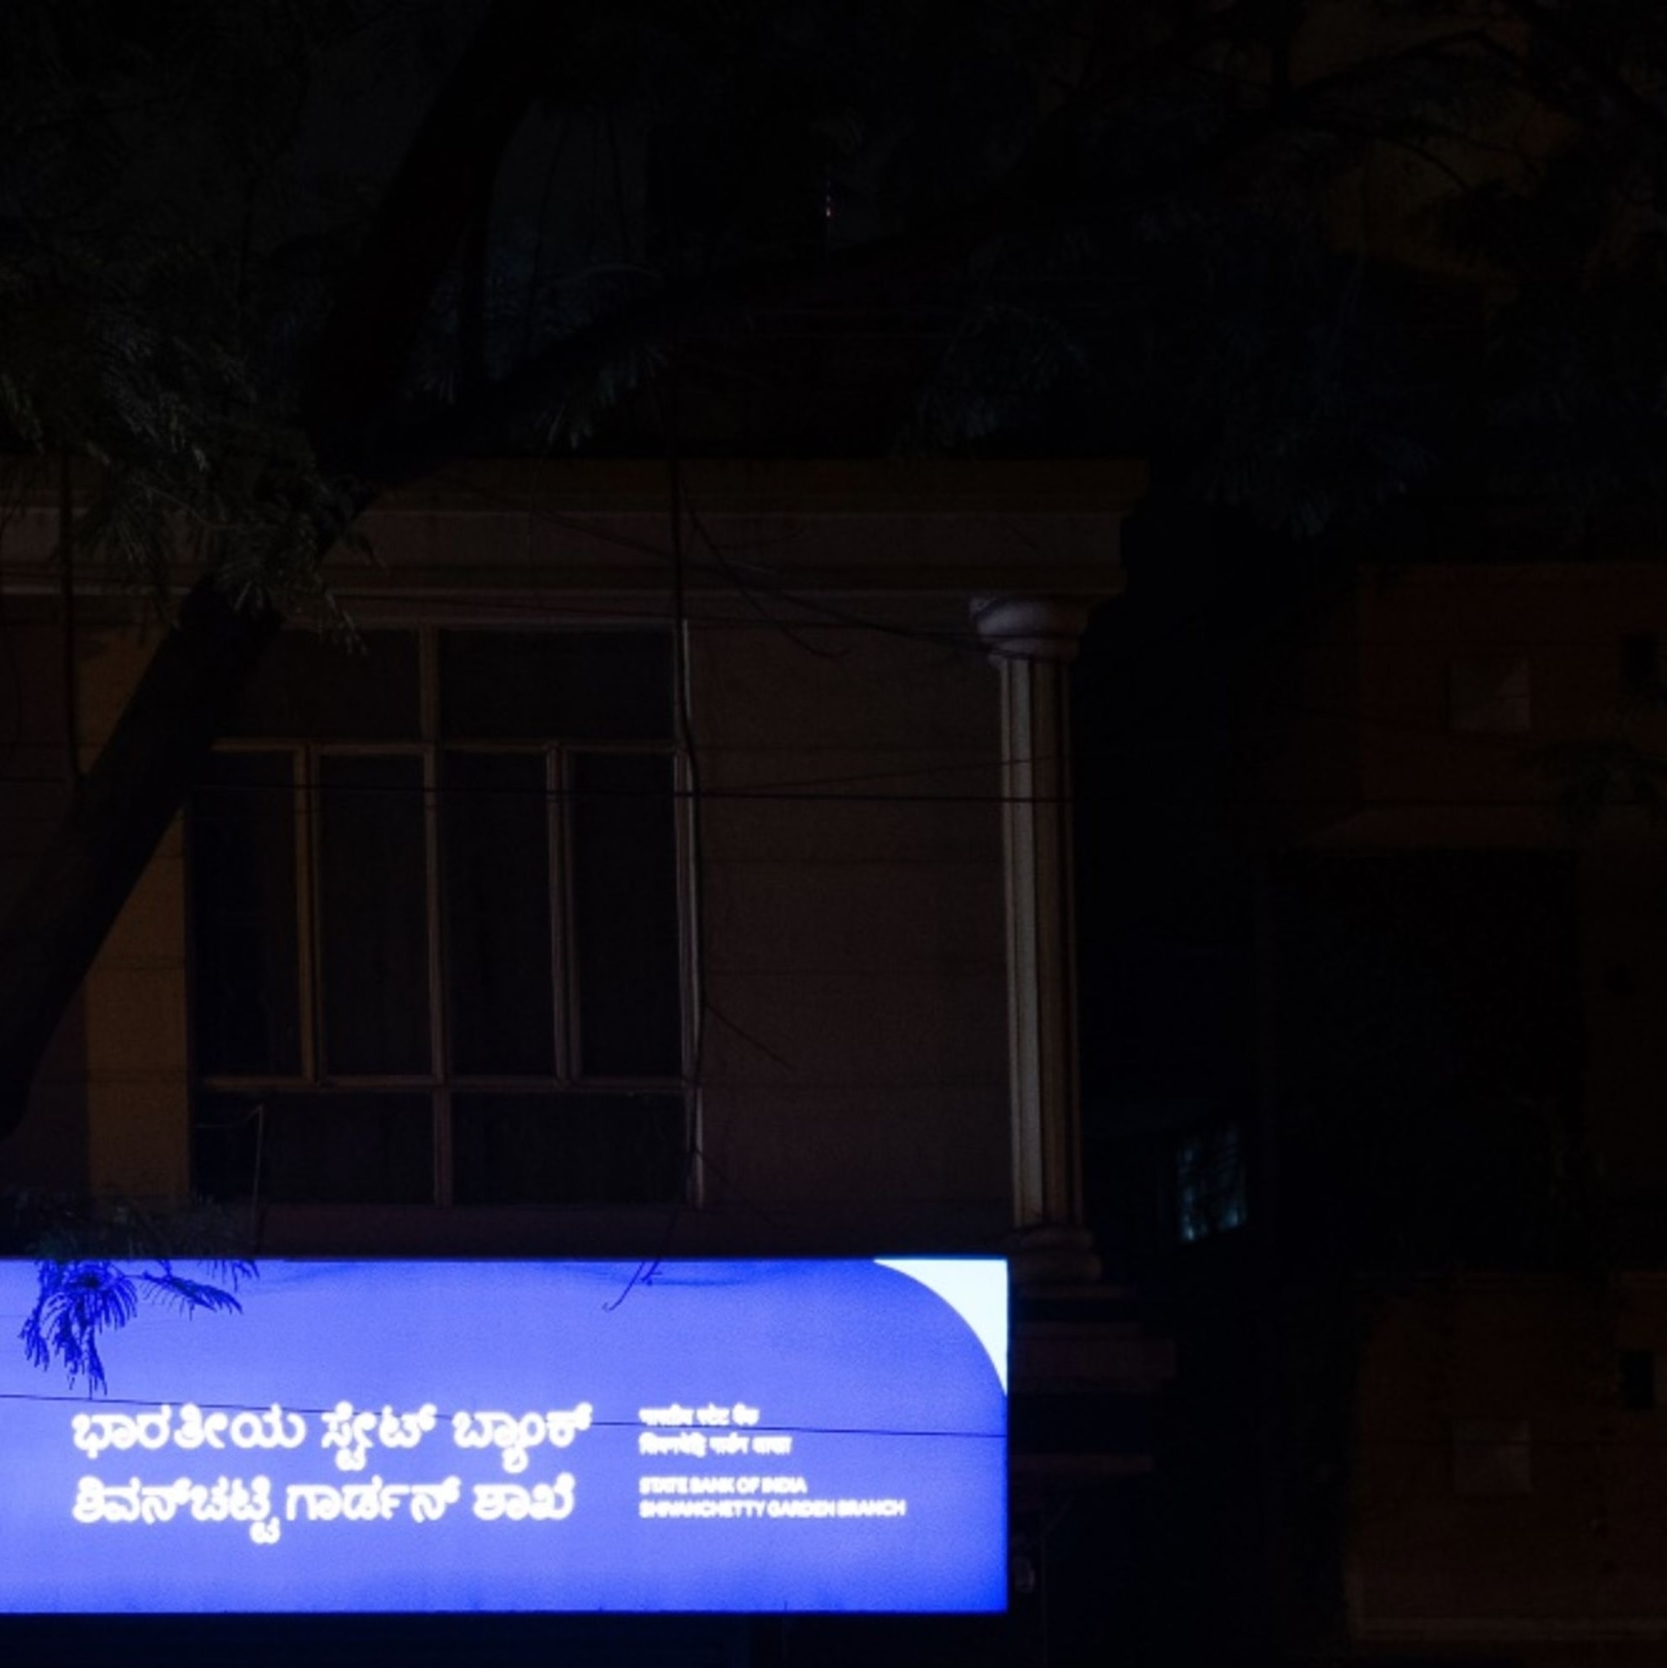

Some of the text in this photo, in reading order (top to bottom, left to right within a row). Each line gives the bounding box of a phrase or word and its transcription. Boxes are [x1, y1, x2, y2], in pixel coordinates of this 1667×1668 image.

[72, 1402, 592, 1473] ಭಾರತೀಯ ಸ್ಟೇಟ್ ಬ್ಯಾಂಕ್
[286, 1476, 461, 1522] ಗಾರ್ಡನ್
[474, 1473, 575, 1520] ಶಾಖೆ
[639, 1477, 807, 1494] STATE BANK OF INDIA
